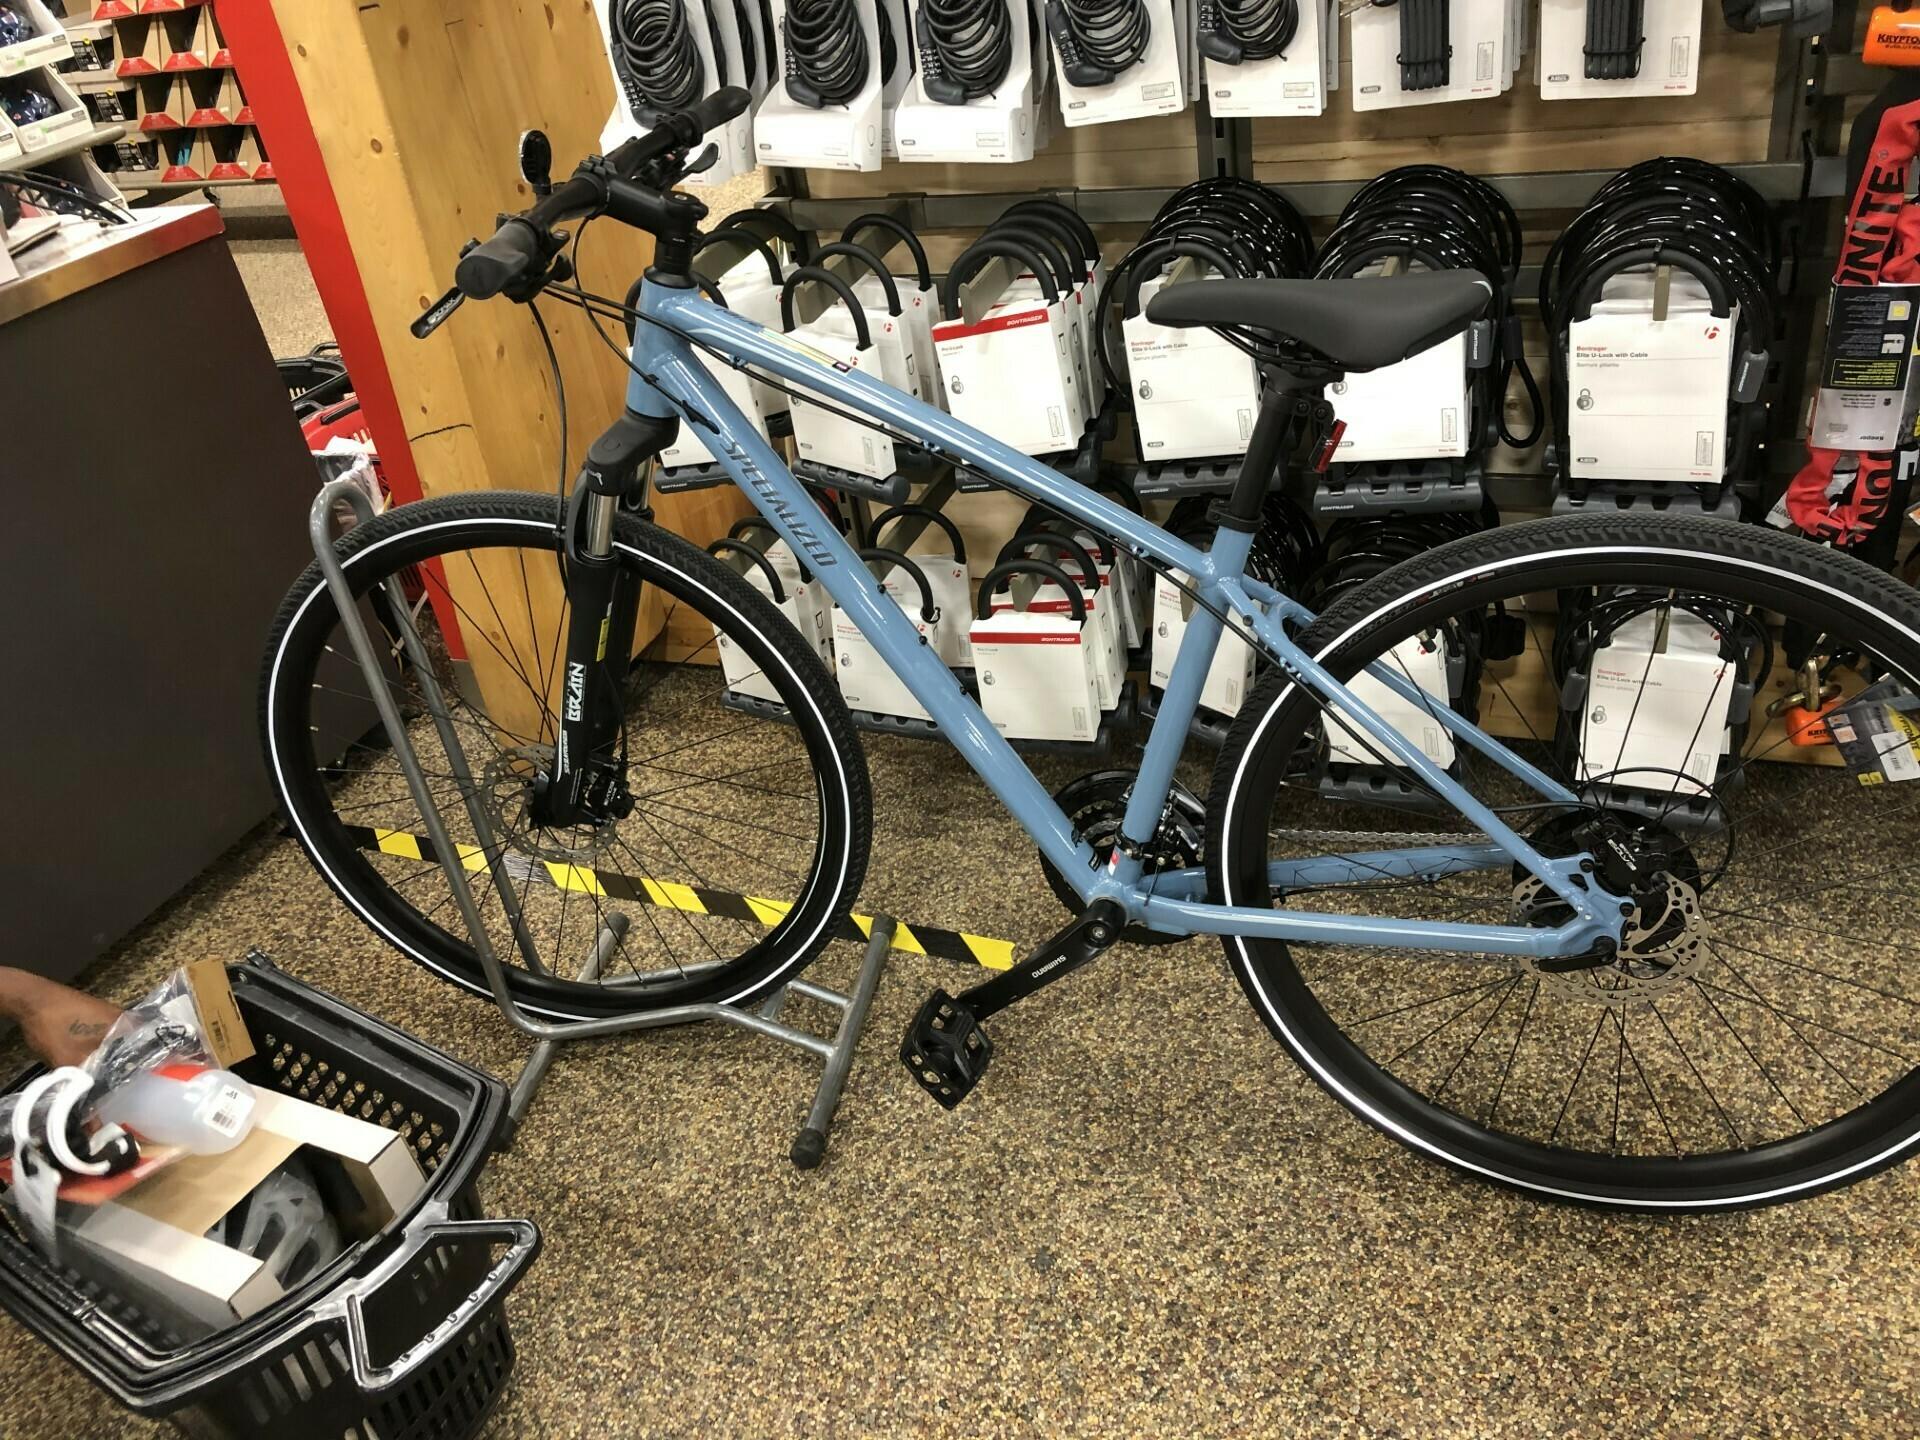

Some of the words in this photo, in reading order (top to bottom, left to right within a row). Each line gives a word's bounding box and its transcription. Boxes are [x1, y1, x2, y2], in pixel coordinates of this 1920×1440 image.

[1006, 314, 1043, 326] BONTRAGER
[1576, 345, 1607, 353] Bontrager
[720, 441, 838, 567] SPECIALIZED
[1320, 503, 1355, 511] BONTRAGER
[567, 662, 585, 722] BRAIN
[1031, 954, 1068, 979] SHIMANO
